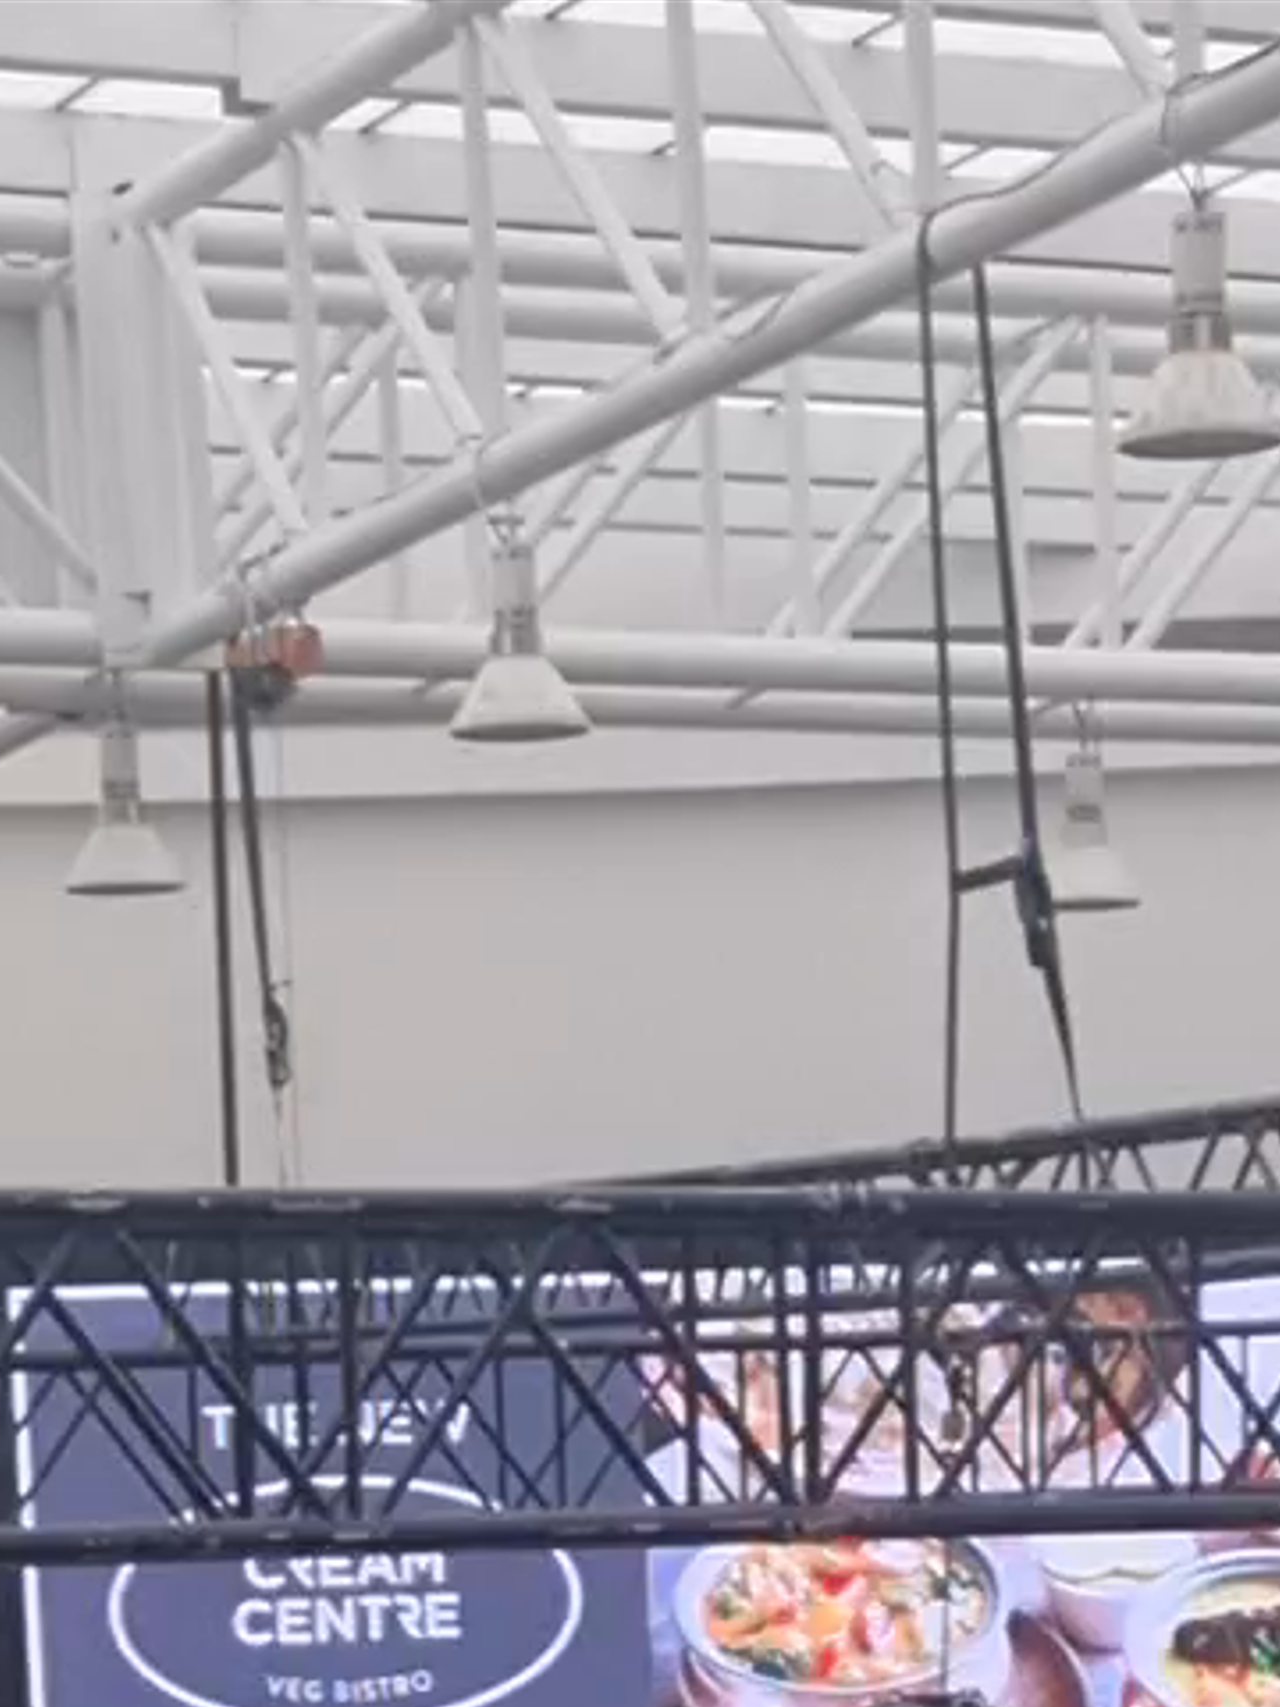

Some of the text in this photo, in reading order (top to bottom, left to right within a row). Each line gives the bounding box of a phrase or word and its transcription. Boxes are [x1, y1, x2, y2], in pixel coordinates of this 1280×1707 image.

[231, 1592, 462, 1646] CENTRE
[266, 1669, 433, 1703] VEG BISTRO
